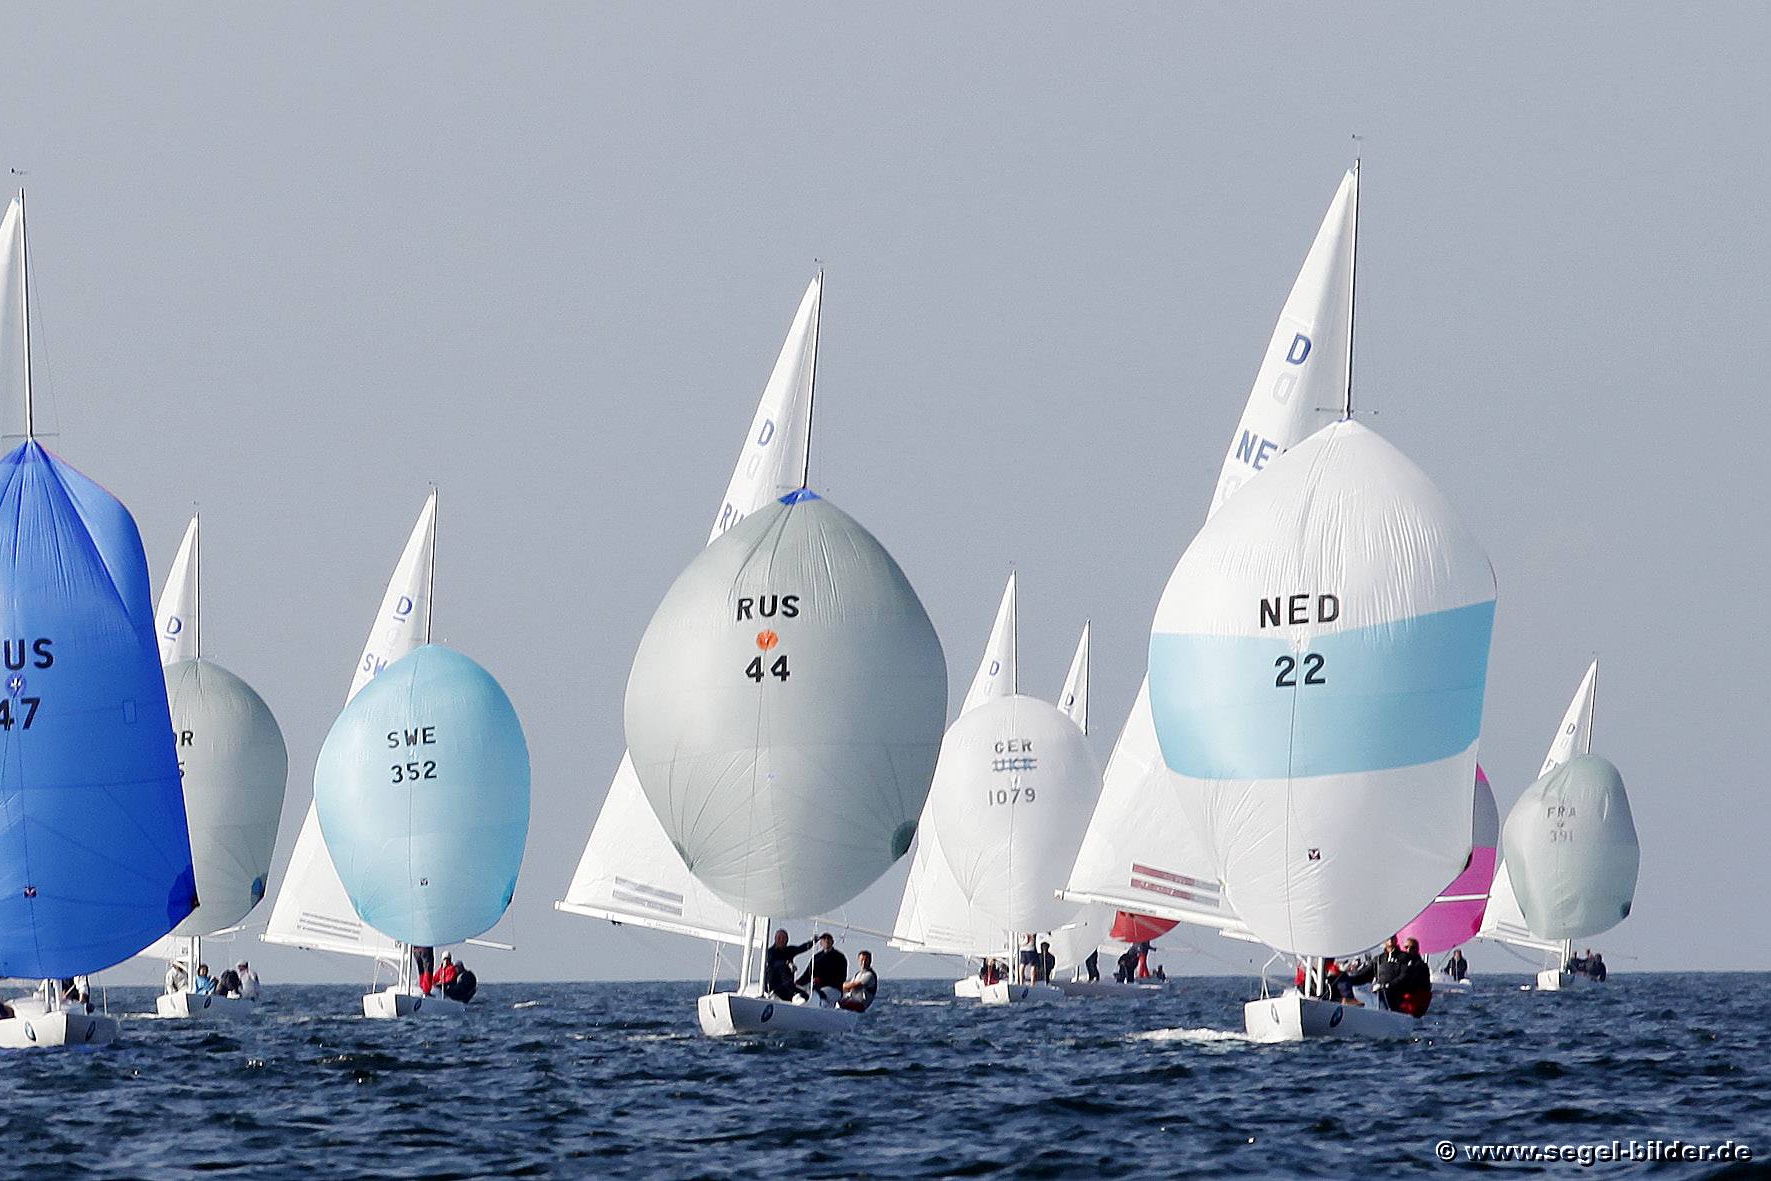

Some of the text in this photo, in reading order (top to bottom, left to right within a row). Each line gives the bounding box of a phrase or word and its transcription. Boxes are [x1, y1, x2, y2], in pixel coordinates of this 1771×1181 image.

[1286, 332, 1313, 366] D
[757, 419, 775, 447] D
[395, 596, 413, 616] D
[736, 594, 801, 622] RUS
[1259, 593, 1340, 629] NED
[166, 615, 183, 635] D
[744, 654, 791, 683] 44
[989, 660, 1000, 676] D
[1274, 652, 1327, 688] 22
[387, 726, 437, 749] SWE
[1566, 722, 1576, 735] D
[994, 738, 1033, 754] GER
[391, 760, 438, 784] 352
[988, 787, 1036, 806] 1079
[1547, 806, 1577, 819] FRA
